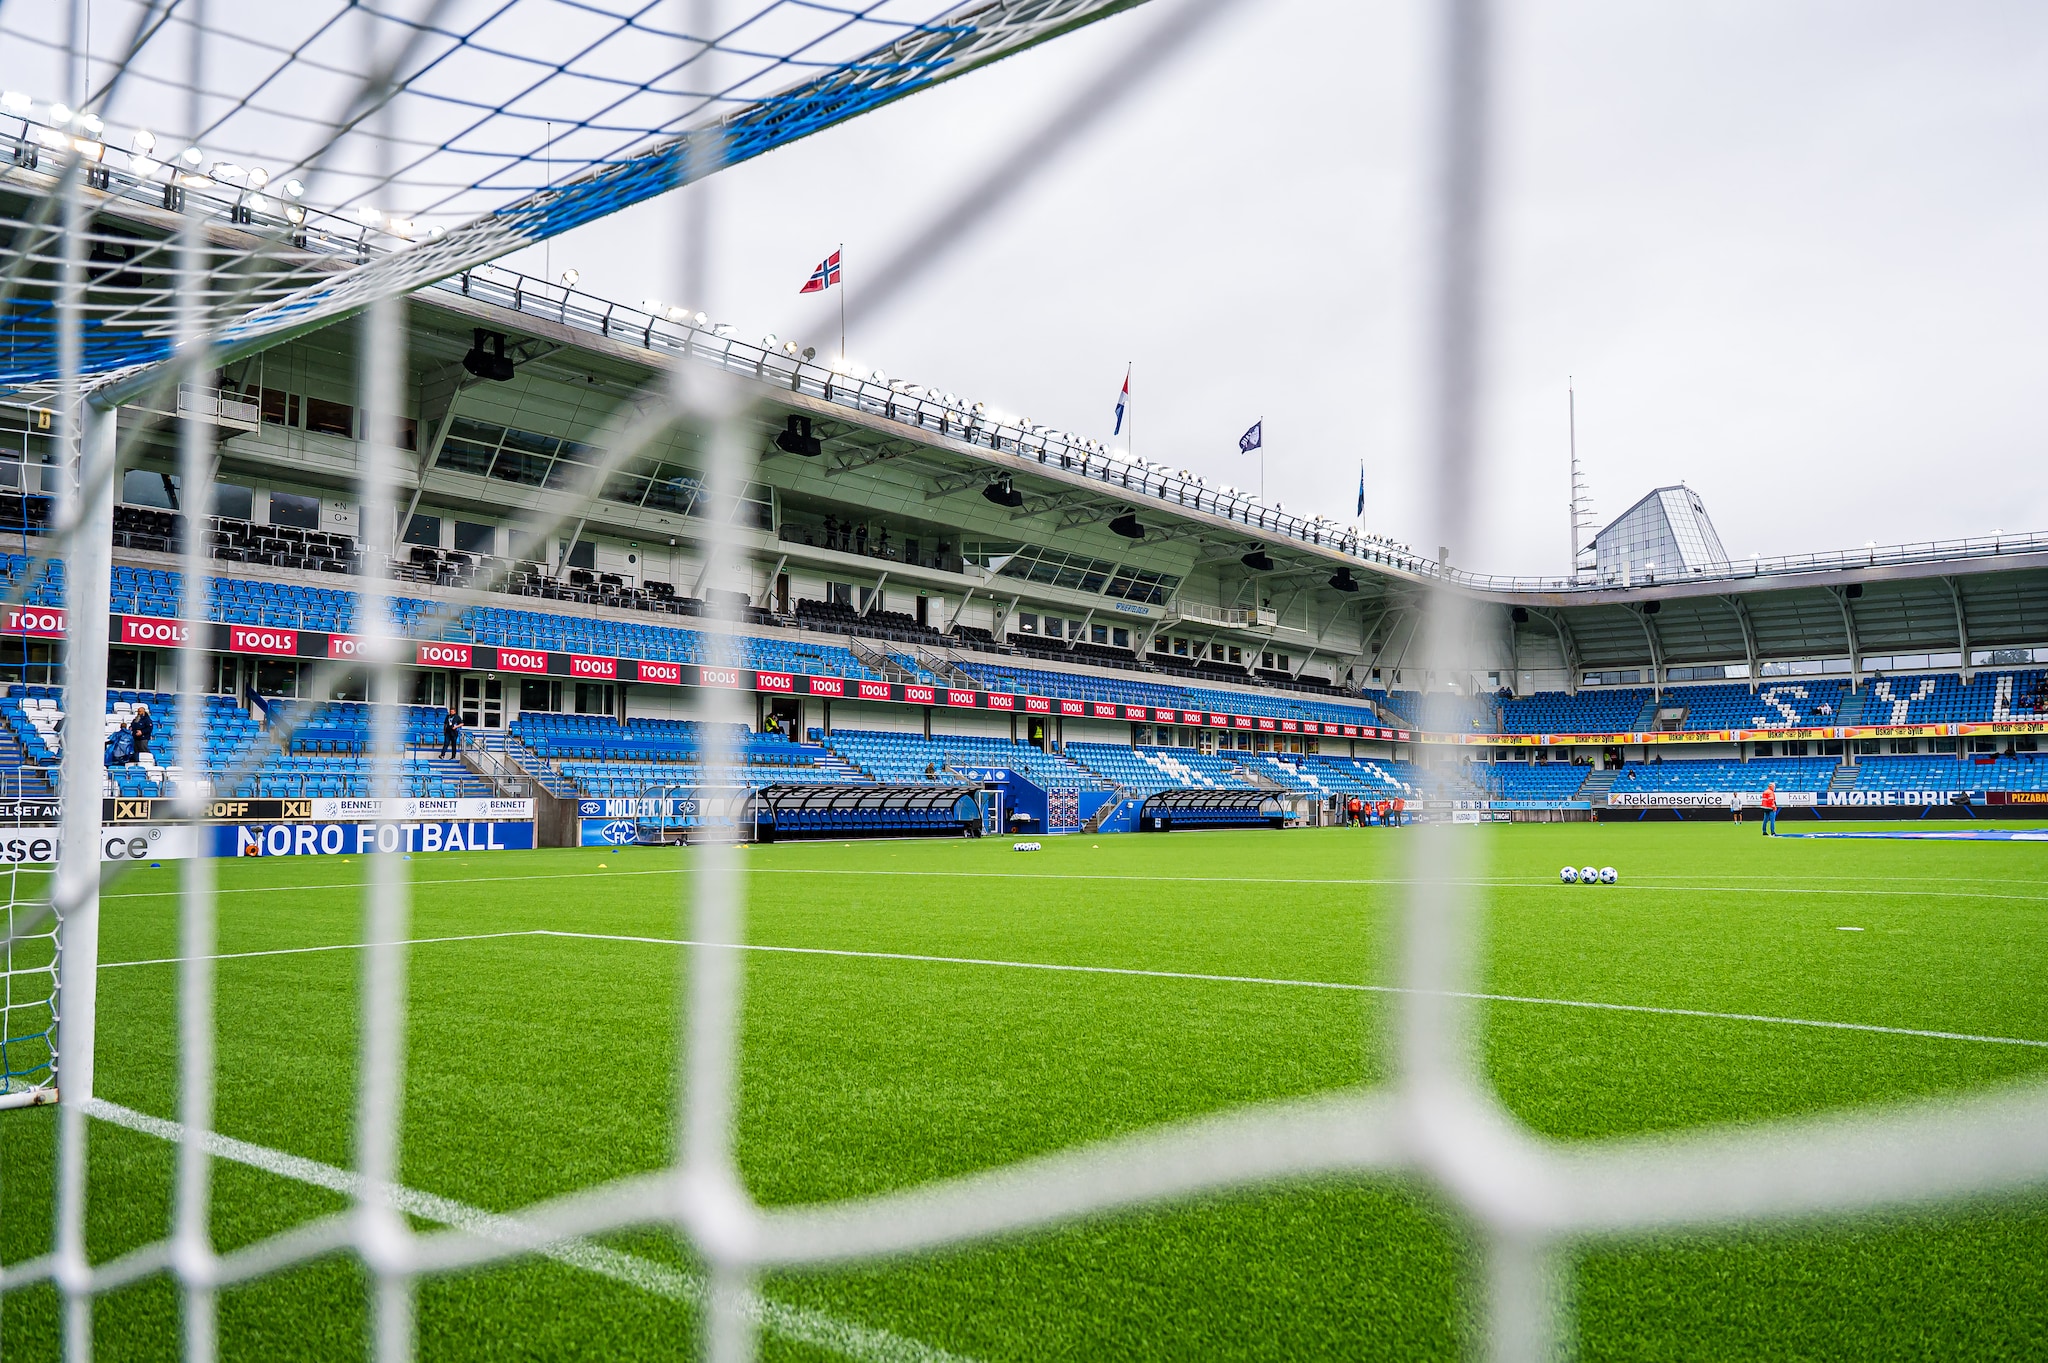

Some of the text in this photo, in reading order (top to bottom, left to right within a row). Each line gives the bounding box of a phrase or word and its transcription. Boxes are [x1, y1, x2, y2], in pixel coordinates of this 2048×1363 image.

[8, 612, 67, 632] TOOL
[128, 622, 190, 642] TOOLS
[236, 632, 292, 650] TOOLS
[422, 646, 468, 662] TOOLS
[502, 653, 544, 669] TOOLS
[574, 660, 613, 674] TOOLS
[641, 665, 678, 680] TOOLS
[702, 670, 736, 684] TOOLS
[760, 675, 790, 688] TOOLS
[812, 680, 841, 693] TOOLS
[861, 684, 888, 696] TOOLS
[907, 688, 932, 700] TOOLS
[950, 692, 973, 704] TOOLS
[990, 696, 1012, 707] TOOLS
[1028, 699, 1048, 710] TOOLS
[1063, 702, 1082, 713] TOOLS
[1096, 706, 1114, 715] TOOLS
[1127, 708, 1144, 718] TOOLS
[1157, 711, 1173, 720] TOOLS
[1185, 713, 1200, 722] TOOLS
[1211, 716, 1226, 724] TOOLS
[1236, 718, 1250, 726] TOOLS
[1259, 720, 1274, 729] TOOLS
[1282, 722, 1296, 730] TOOLS
[1304, 724, 1318, 732] TOOLS
[1875, 728, 1894, 736] Oskar
[1992, 724, 2012, 732] Oskar
[1669, 733, 1684, 741] Oskar
[1768, 730, 1784, 738] Oskar
[1624, 794, 1722, 805] Reklameservice
[1827, 791, 1898, 805] MØRE
[118, 802, 147, 818] XL
[284, 802, 310, 816] XL
[237, 823, 504, 857] NORO FOTBALL
